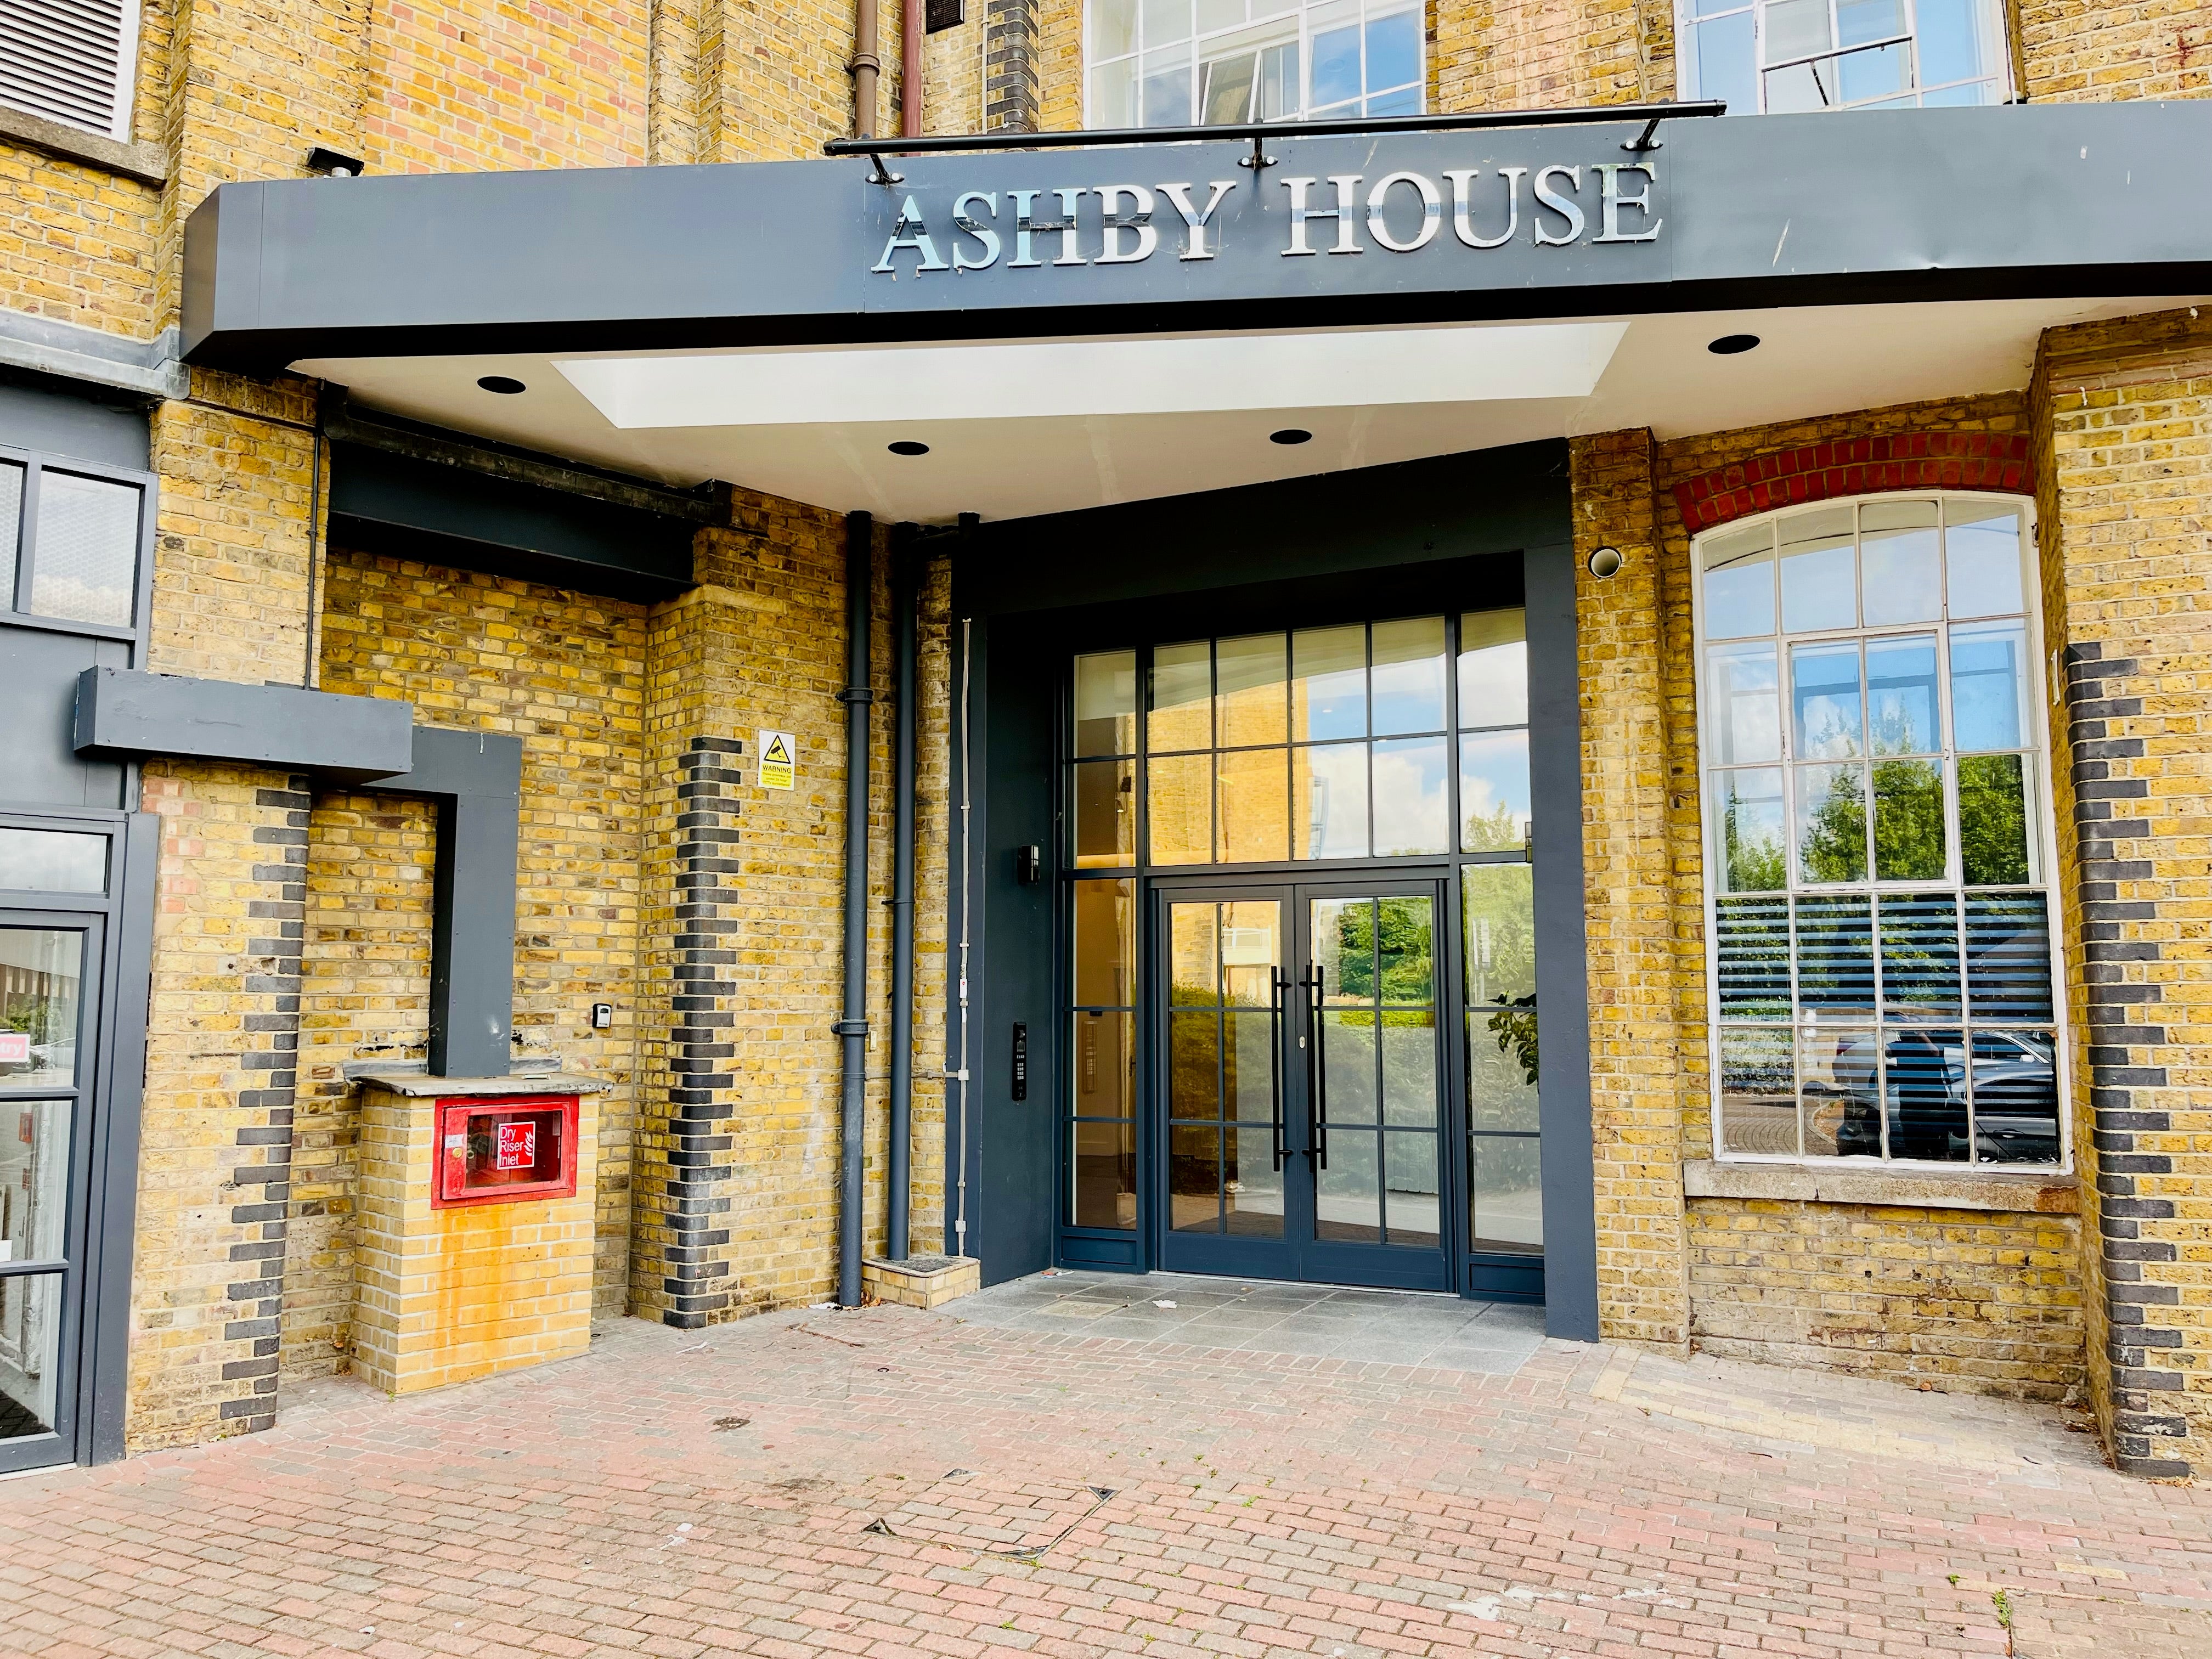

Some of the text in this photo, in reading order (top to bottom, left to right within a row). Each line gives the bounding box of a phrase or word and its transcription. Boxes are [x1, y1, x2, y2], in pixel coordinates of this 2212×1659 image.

[870, 162, 1663, 272] ASHBY HOUSE
[500, 1126, 516, 1142] Dry
[500, 1139, 524, 1153] Riser
[500, 1153, 520, 1166] Inlet
